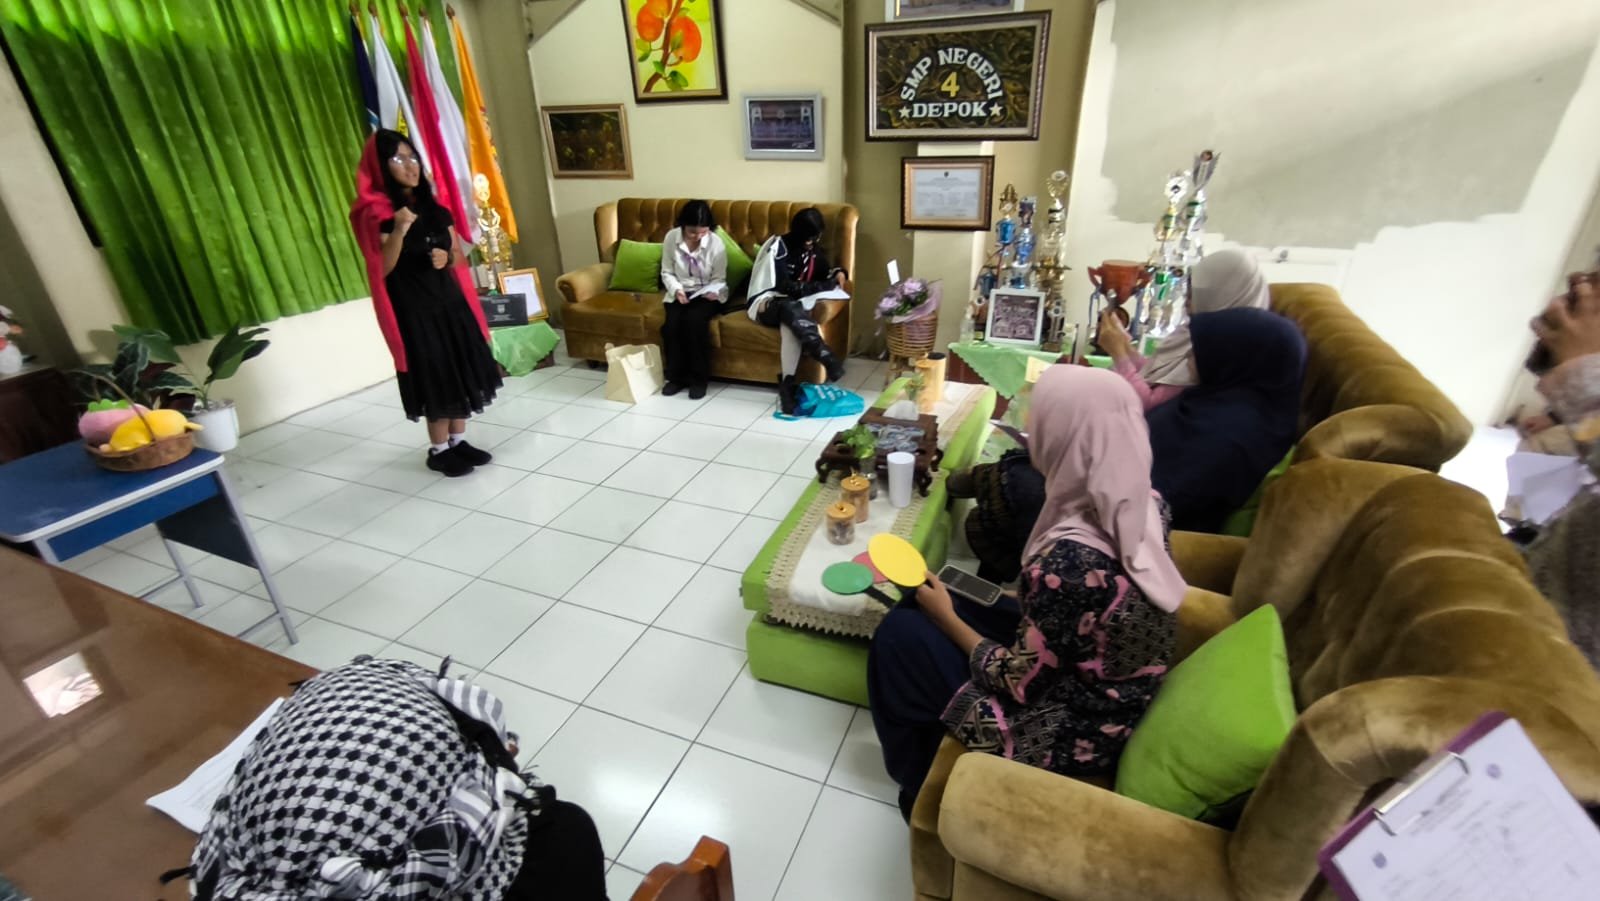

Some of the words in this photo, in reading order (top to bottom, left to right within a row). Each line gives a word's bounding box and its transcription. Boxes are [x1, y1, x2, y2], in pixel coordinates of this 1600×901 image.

[900, 57, 932, 101] SMP
[937, 47, 1003, 100] NEGERI
[941, 71, 960, 98] 4
[912, 101, 987, 118] DEPOK
